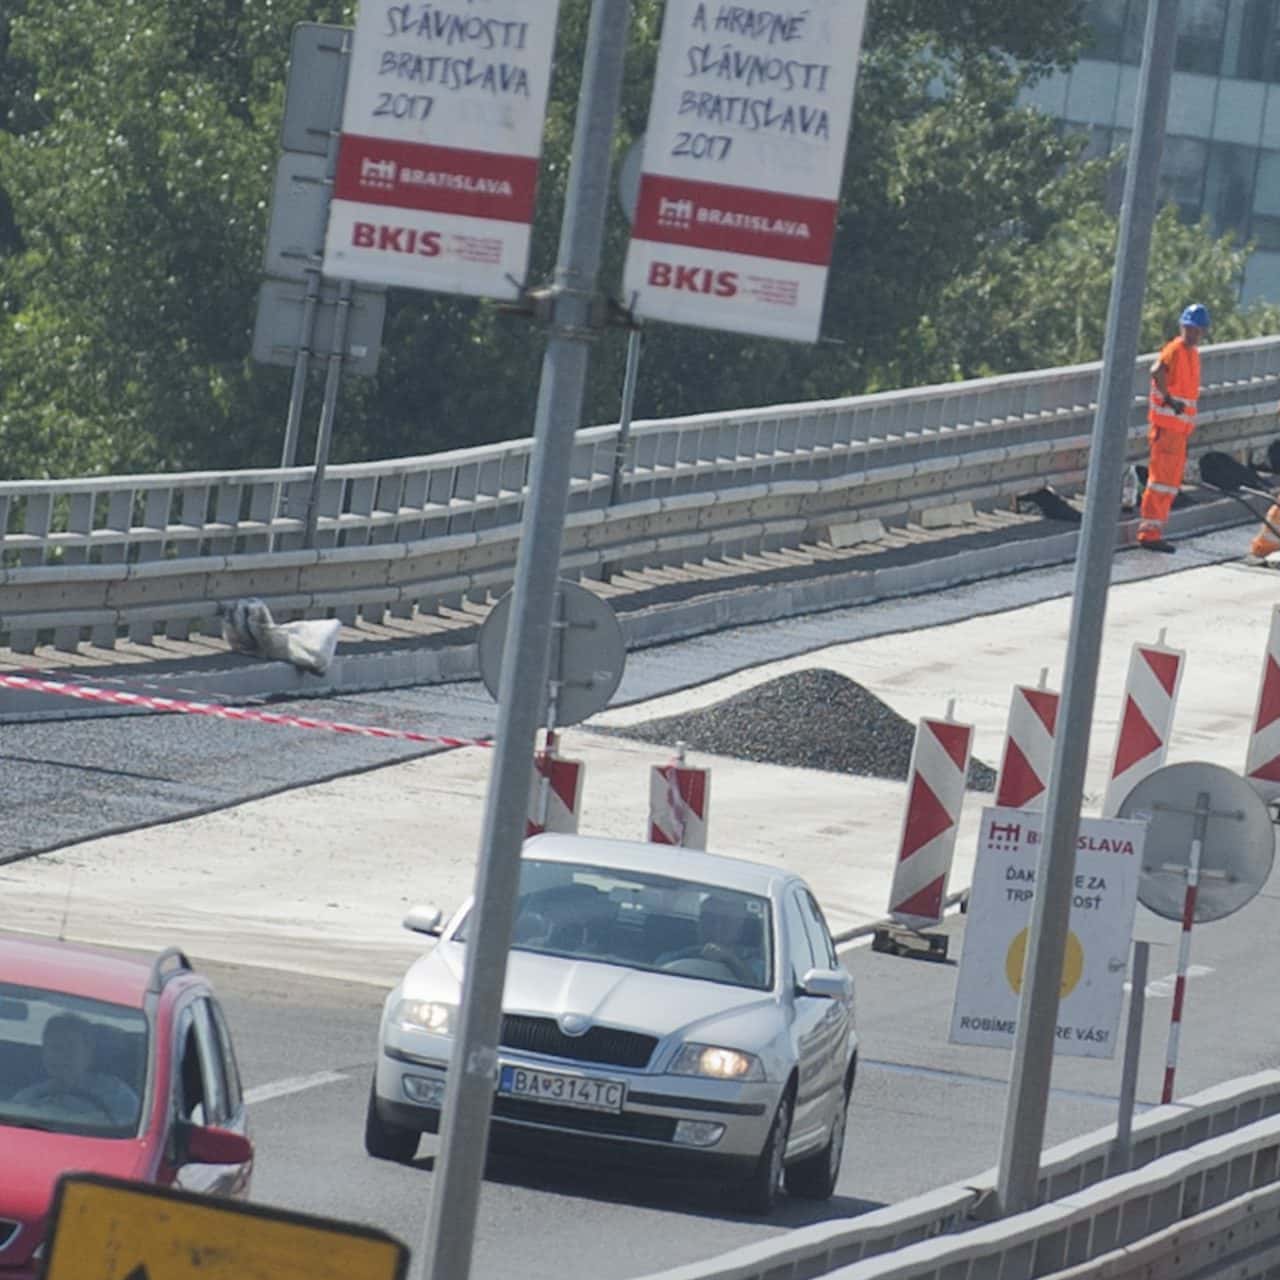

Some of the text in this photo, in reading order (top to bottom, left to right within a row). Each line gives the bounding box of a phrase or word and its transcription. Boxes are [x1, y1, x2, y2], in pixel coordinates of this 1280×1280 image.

[384, 3, 529, 49] SLÁVNOSTI
[691, 3, 810, 44] A HRADNÉ
[378, 50, 530, 97] BRATISLAVA
[685, 43, 831, 92] SLÁVNOSTI
[372, 92, 434, 120] 2017
[677, 90, 829, 141] BRATISLAVA
[671, 132, 733, 160] 2017
[399, 166, 512, 197] BRATISLAVA
[352, 221, 442, 257] BKIS
[696, 207, 811, 238] BRATISLAVA
[647, 261, 739, 298] BKIS
[1026, 830, 1134, 855] BSLAVA
[1087, 876, 1107, 890] ZA
